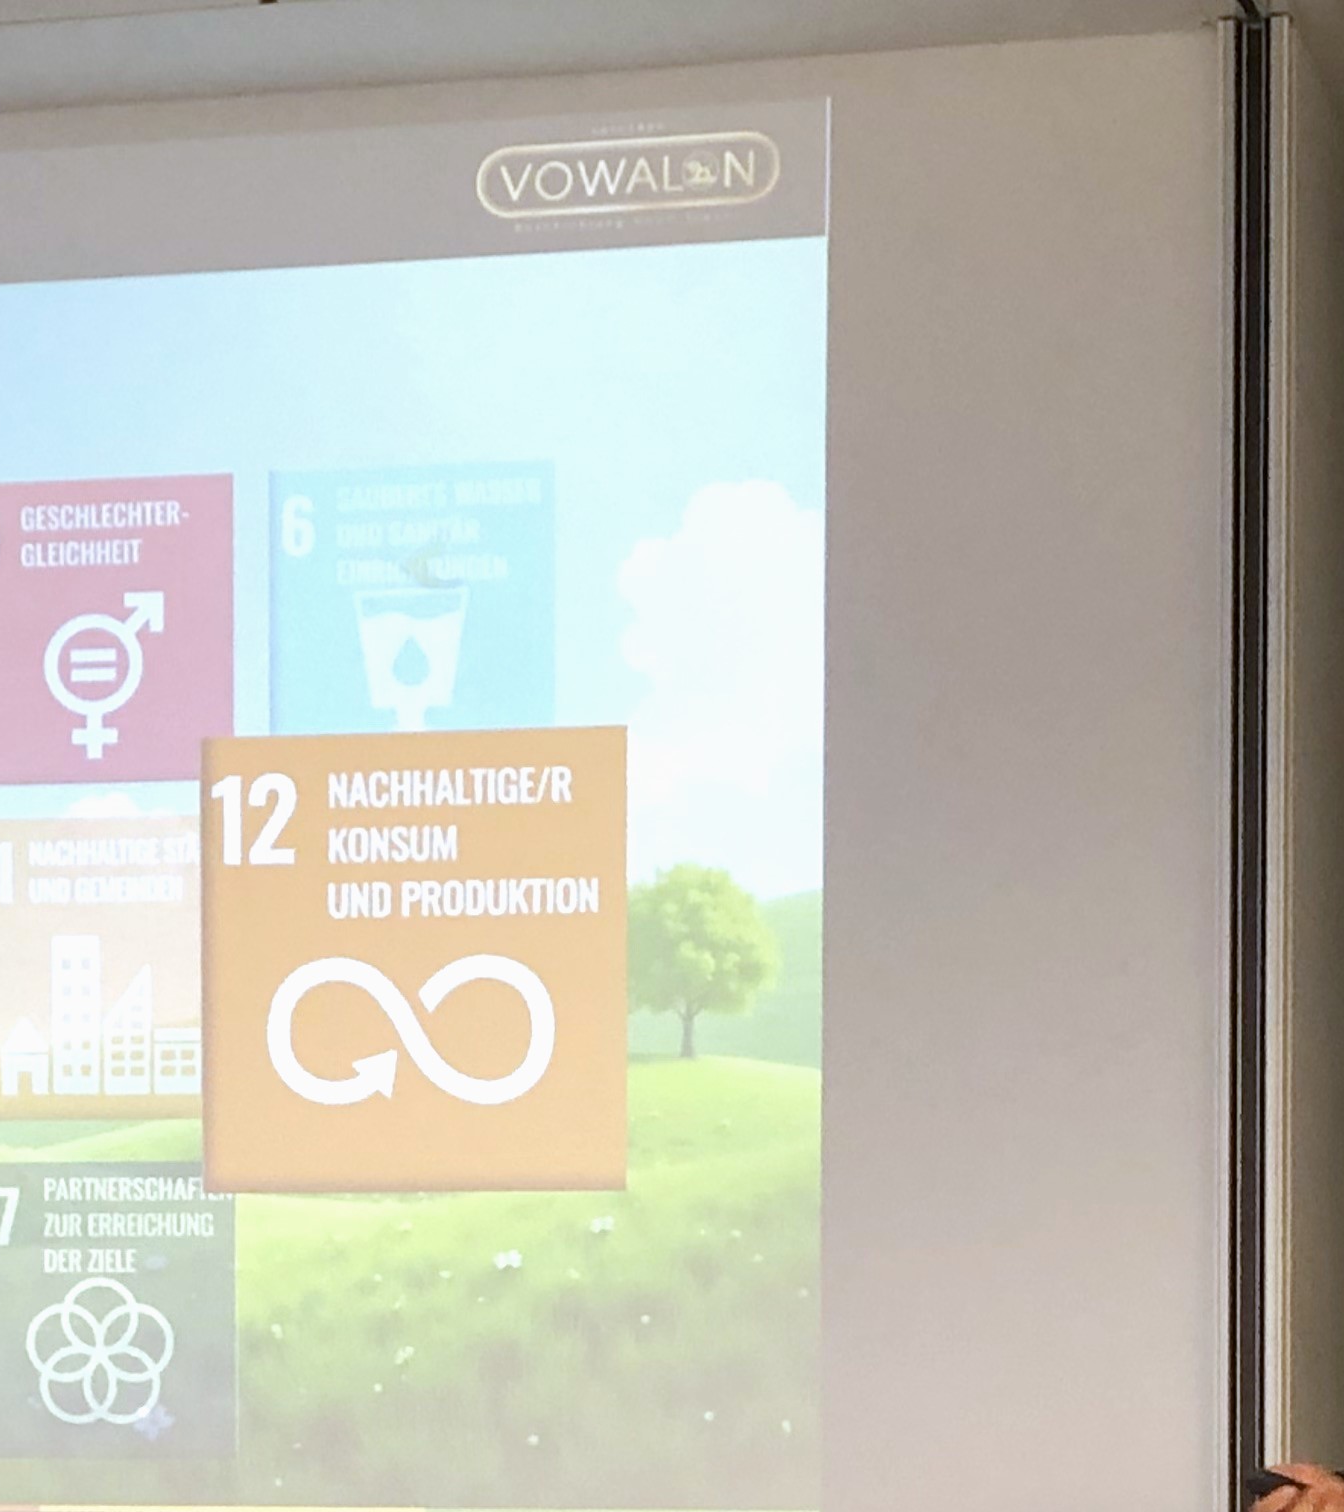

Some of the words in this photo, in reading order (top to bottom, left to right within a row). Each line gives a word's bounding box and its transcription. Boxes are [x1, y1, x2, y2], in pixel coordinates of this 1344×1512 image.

[21, 501, 188, 532] GESCHLECHTER-
[281, 495, 315, 557] 6
[21, 539, 142, 568] GLEICHHEIT
[328, 766, 572, 809] NACHHALTIGE/R
[211, 772, 297, 866] 12
[328, 825, 457, 864] KONSUM
[327, 882, 391, 919] UND
[401, 877, 599, 917] PRODUKTION
[43, 1177, 234, 1201] PARTNERSCHAF
[43, 1212, 83, 1237] ZUR
[88, 1212, 214, 1237] ERREICHUNG
[43, 1249, 82, 1273] DER
[87, 1249, 136, 1273] ZIELE
